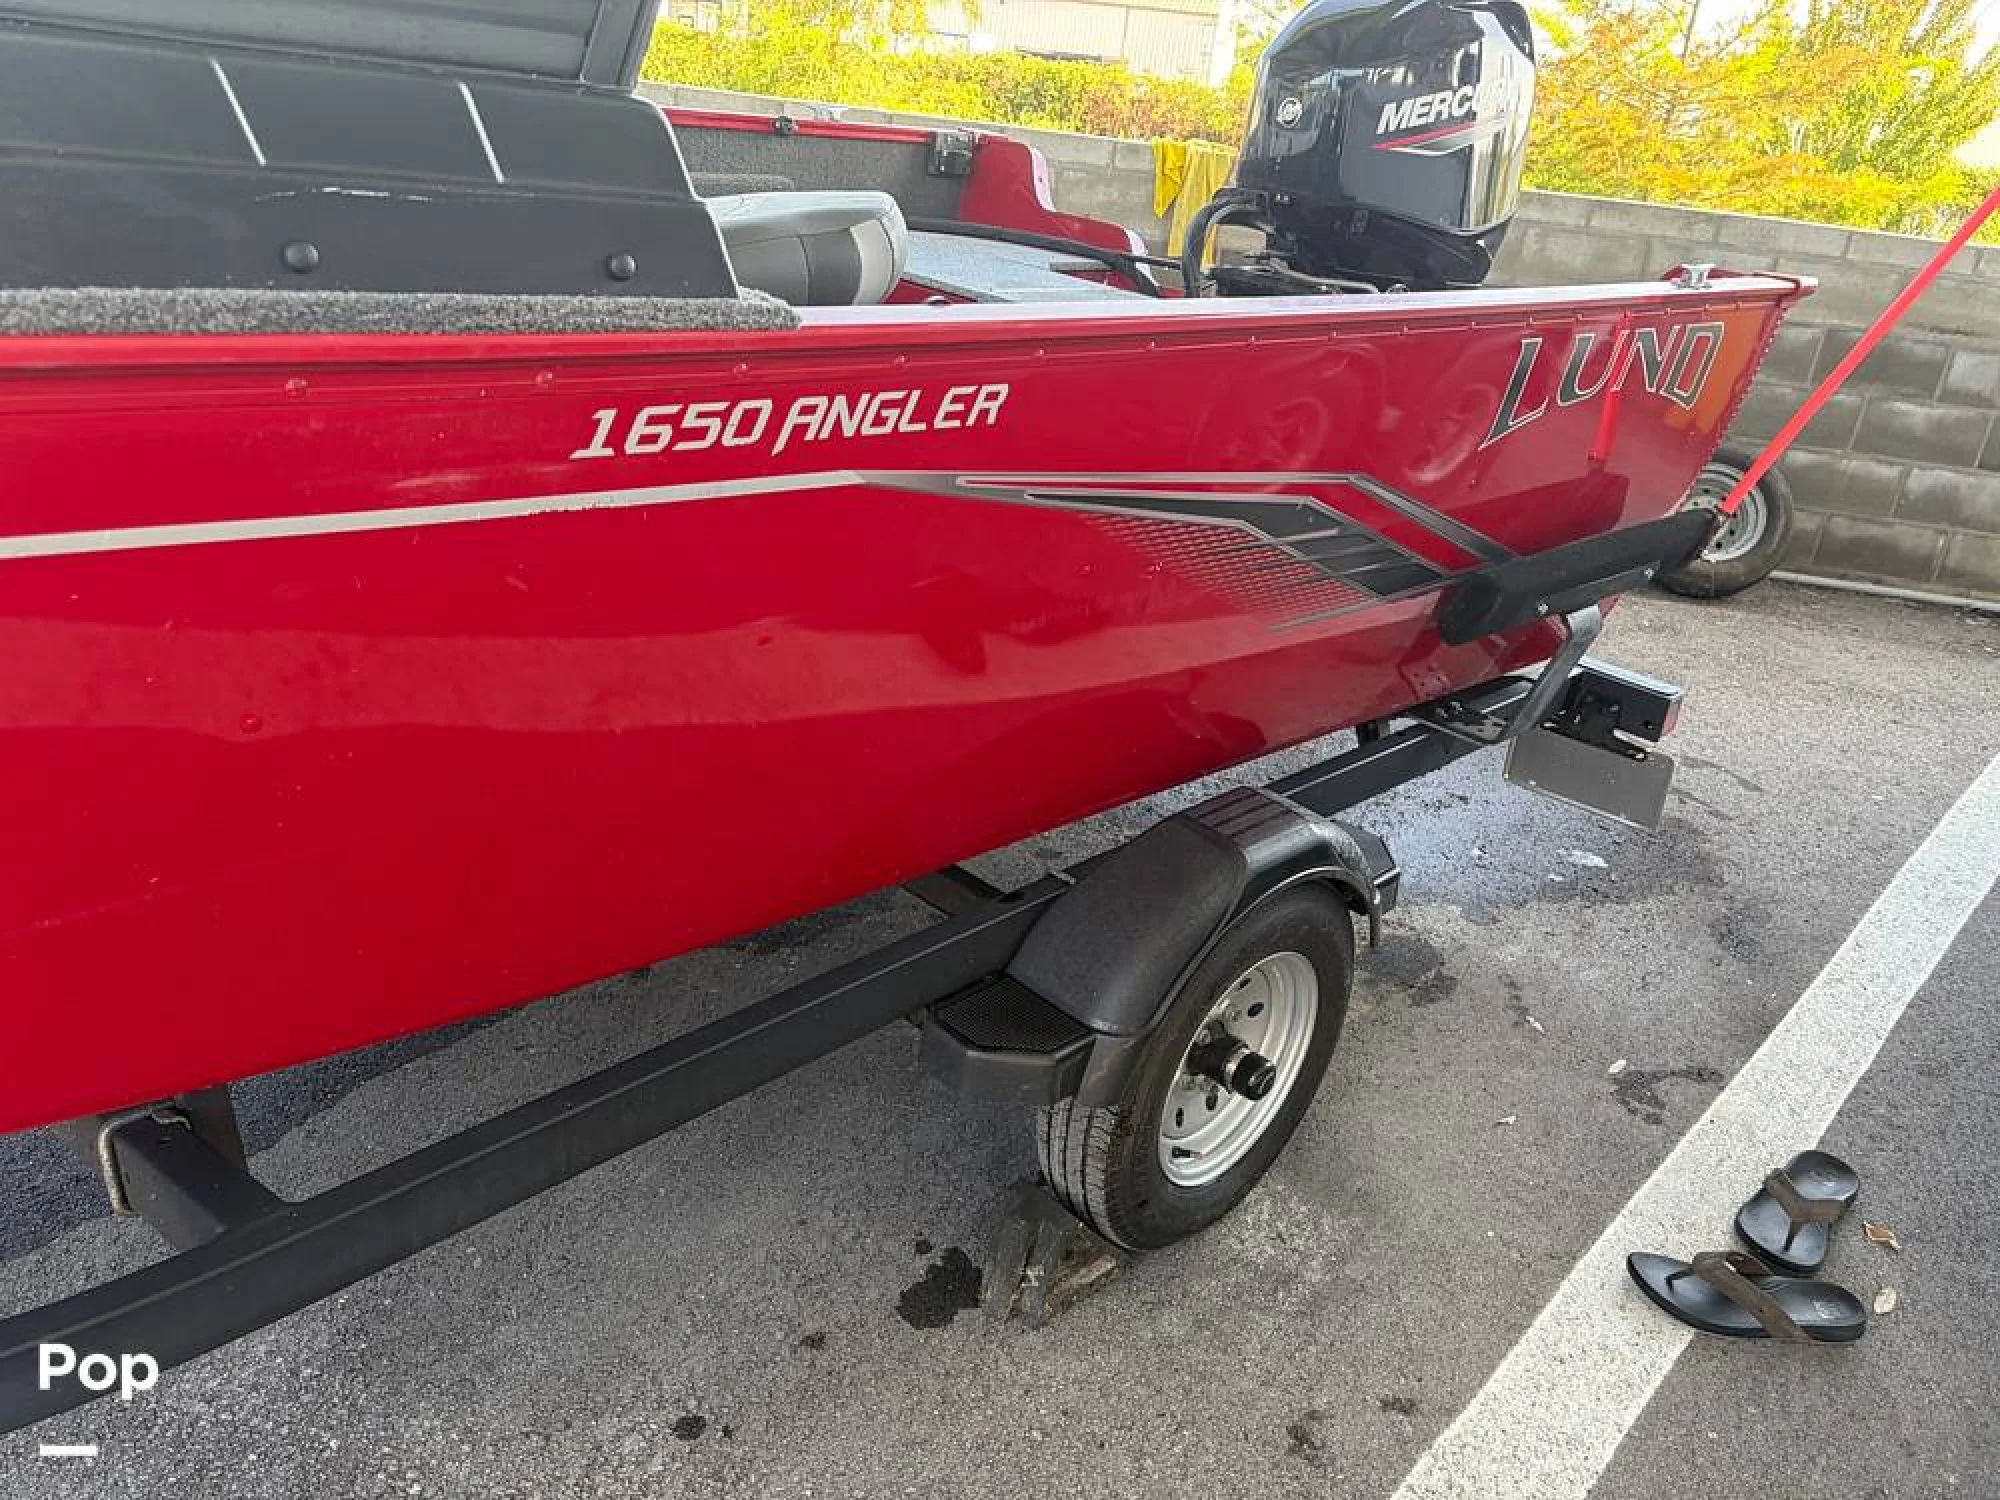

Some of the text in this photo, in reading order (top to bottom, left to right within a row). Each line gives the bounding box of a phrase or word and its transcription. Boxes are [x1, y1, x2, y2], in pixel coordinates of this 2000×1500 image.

[569, 383, 1009, 460] 1650 ANGLER
[1477, 321, 1725, 451] LUND
